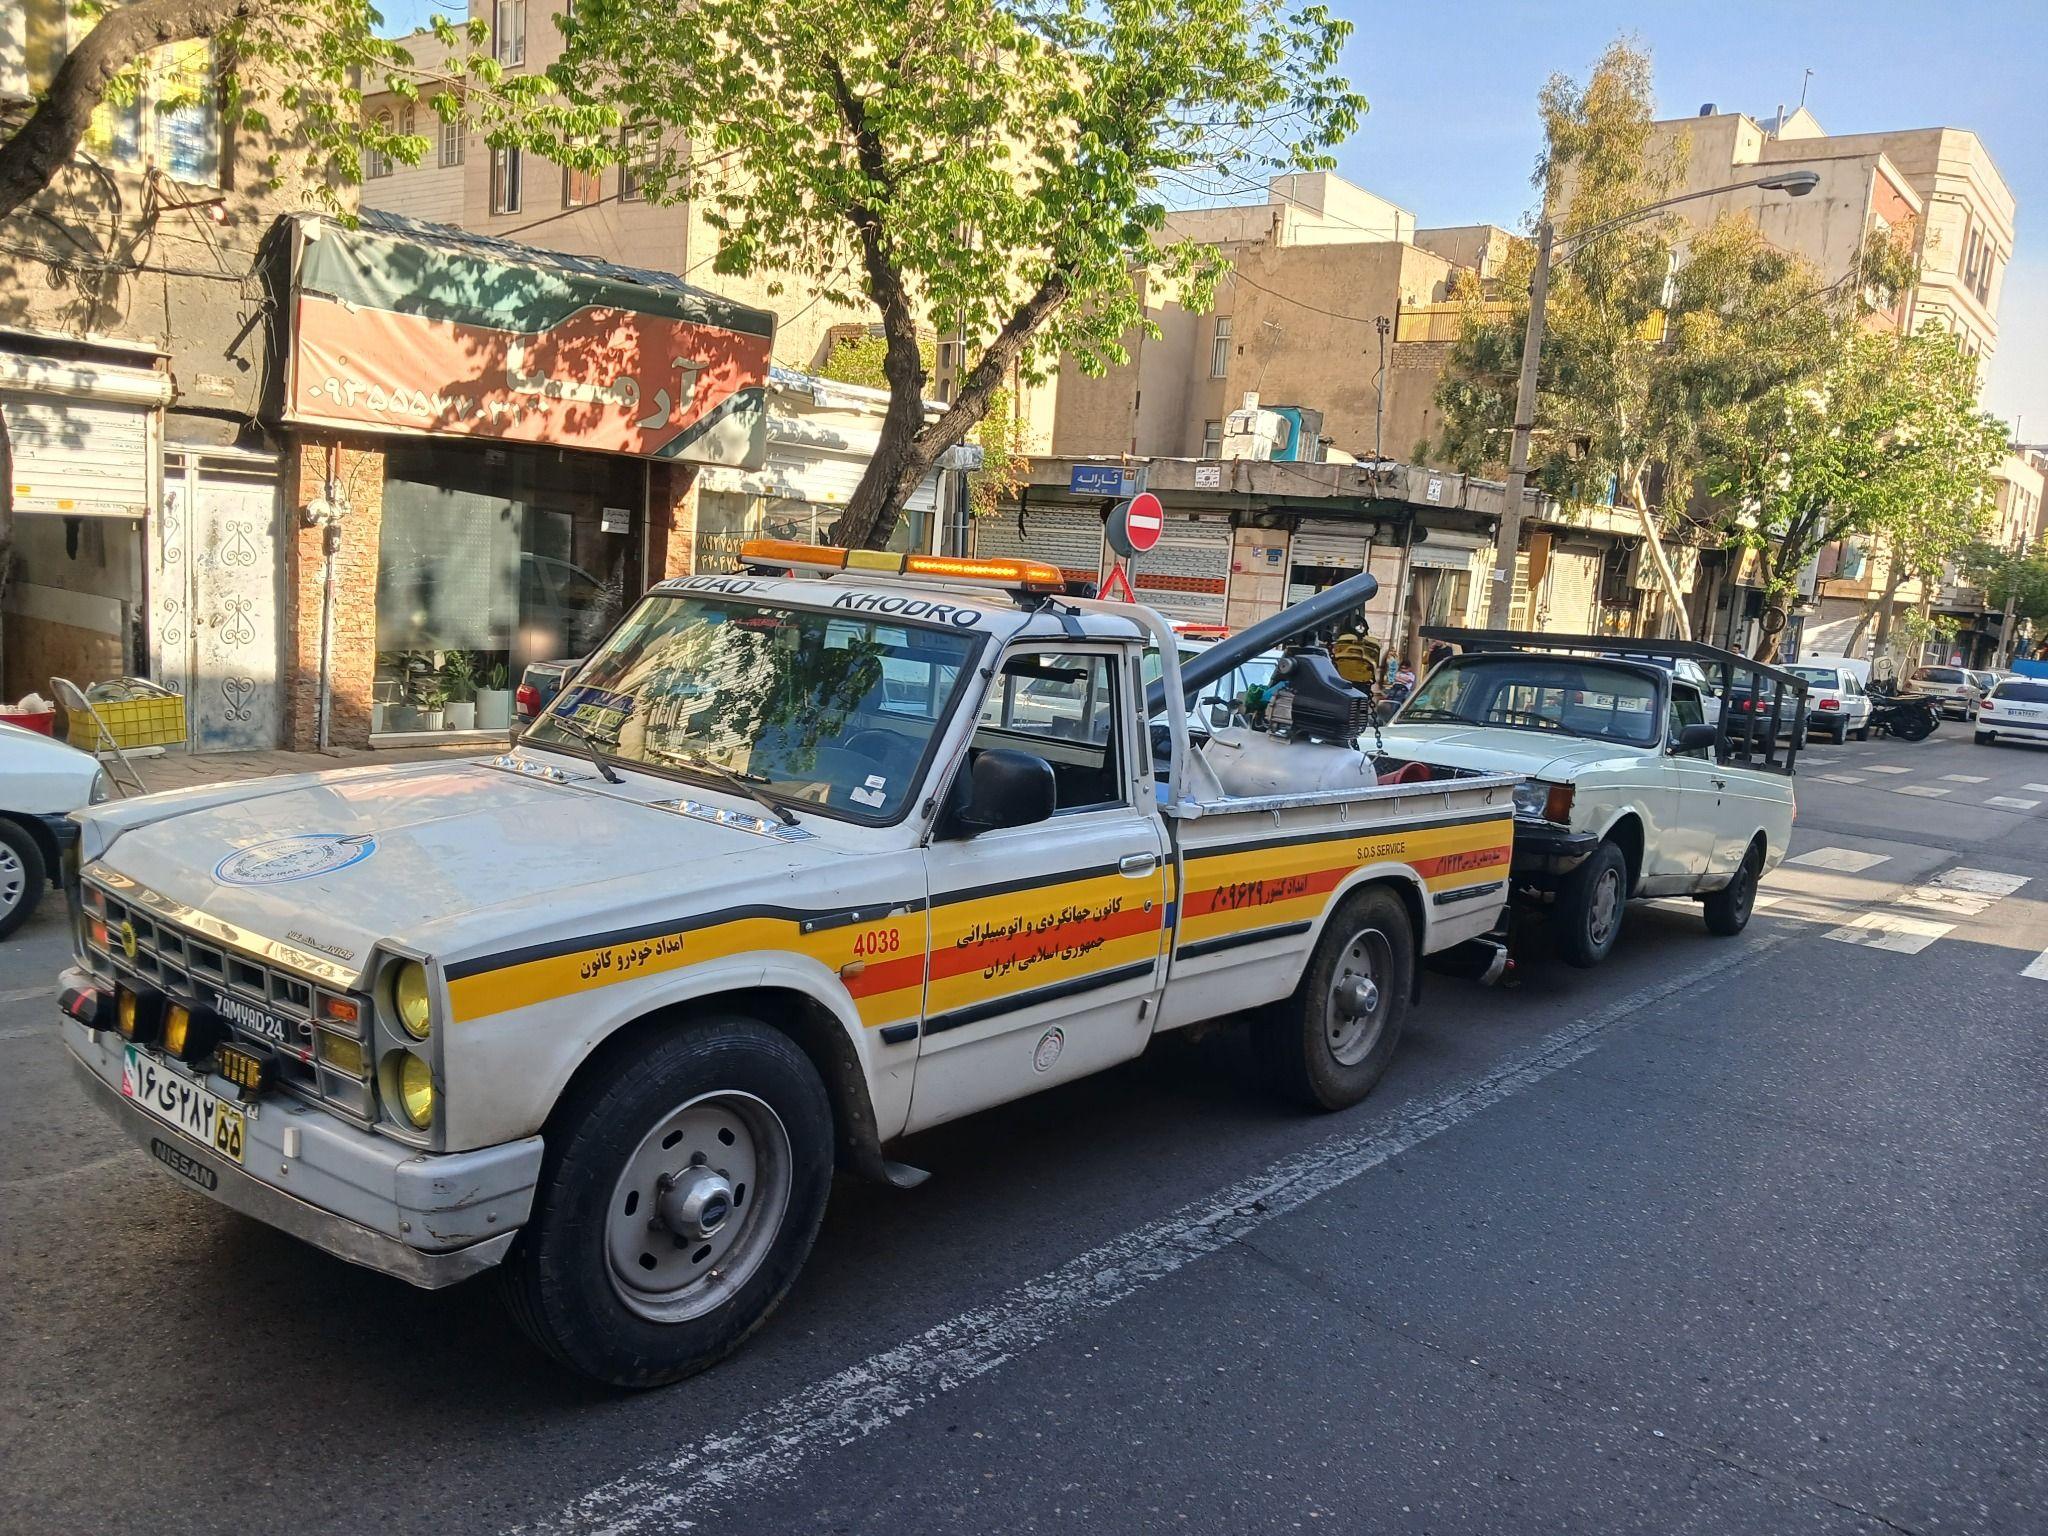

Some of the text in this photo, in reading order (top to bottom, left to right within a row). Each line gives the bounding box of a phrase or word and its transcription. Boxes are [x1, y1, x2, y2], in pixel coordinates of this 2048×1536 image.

[832, 591, 982, 628] KHODRO
[1376, 842, 1405, 857] SERVICE
[853, 929, 900, 958] 4038
[956, 896, 1123, 949] کانون جهانگردی و اتومبیلرانی
[580, 934, 684, 979] امداد خودرو کانون
[983, 935, 1105, 979] جمهوری اسلامی ایران
[154, 1140, 214, 1189] NISSAN
